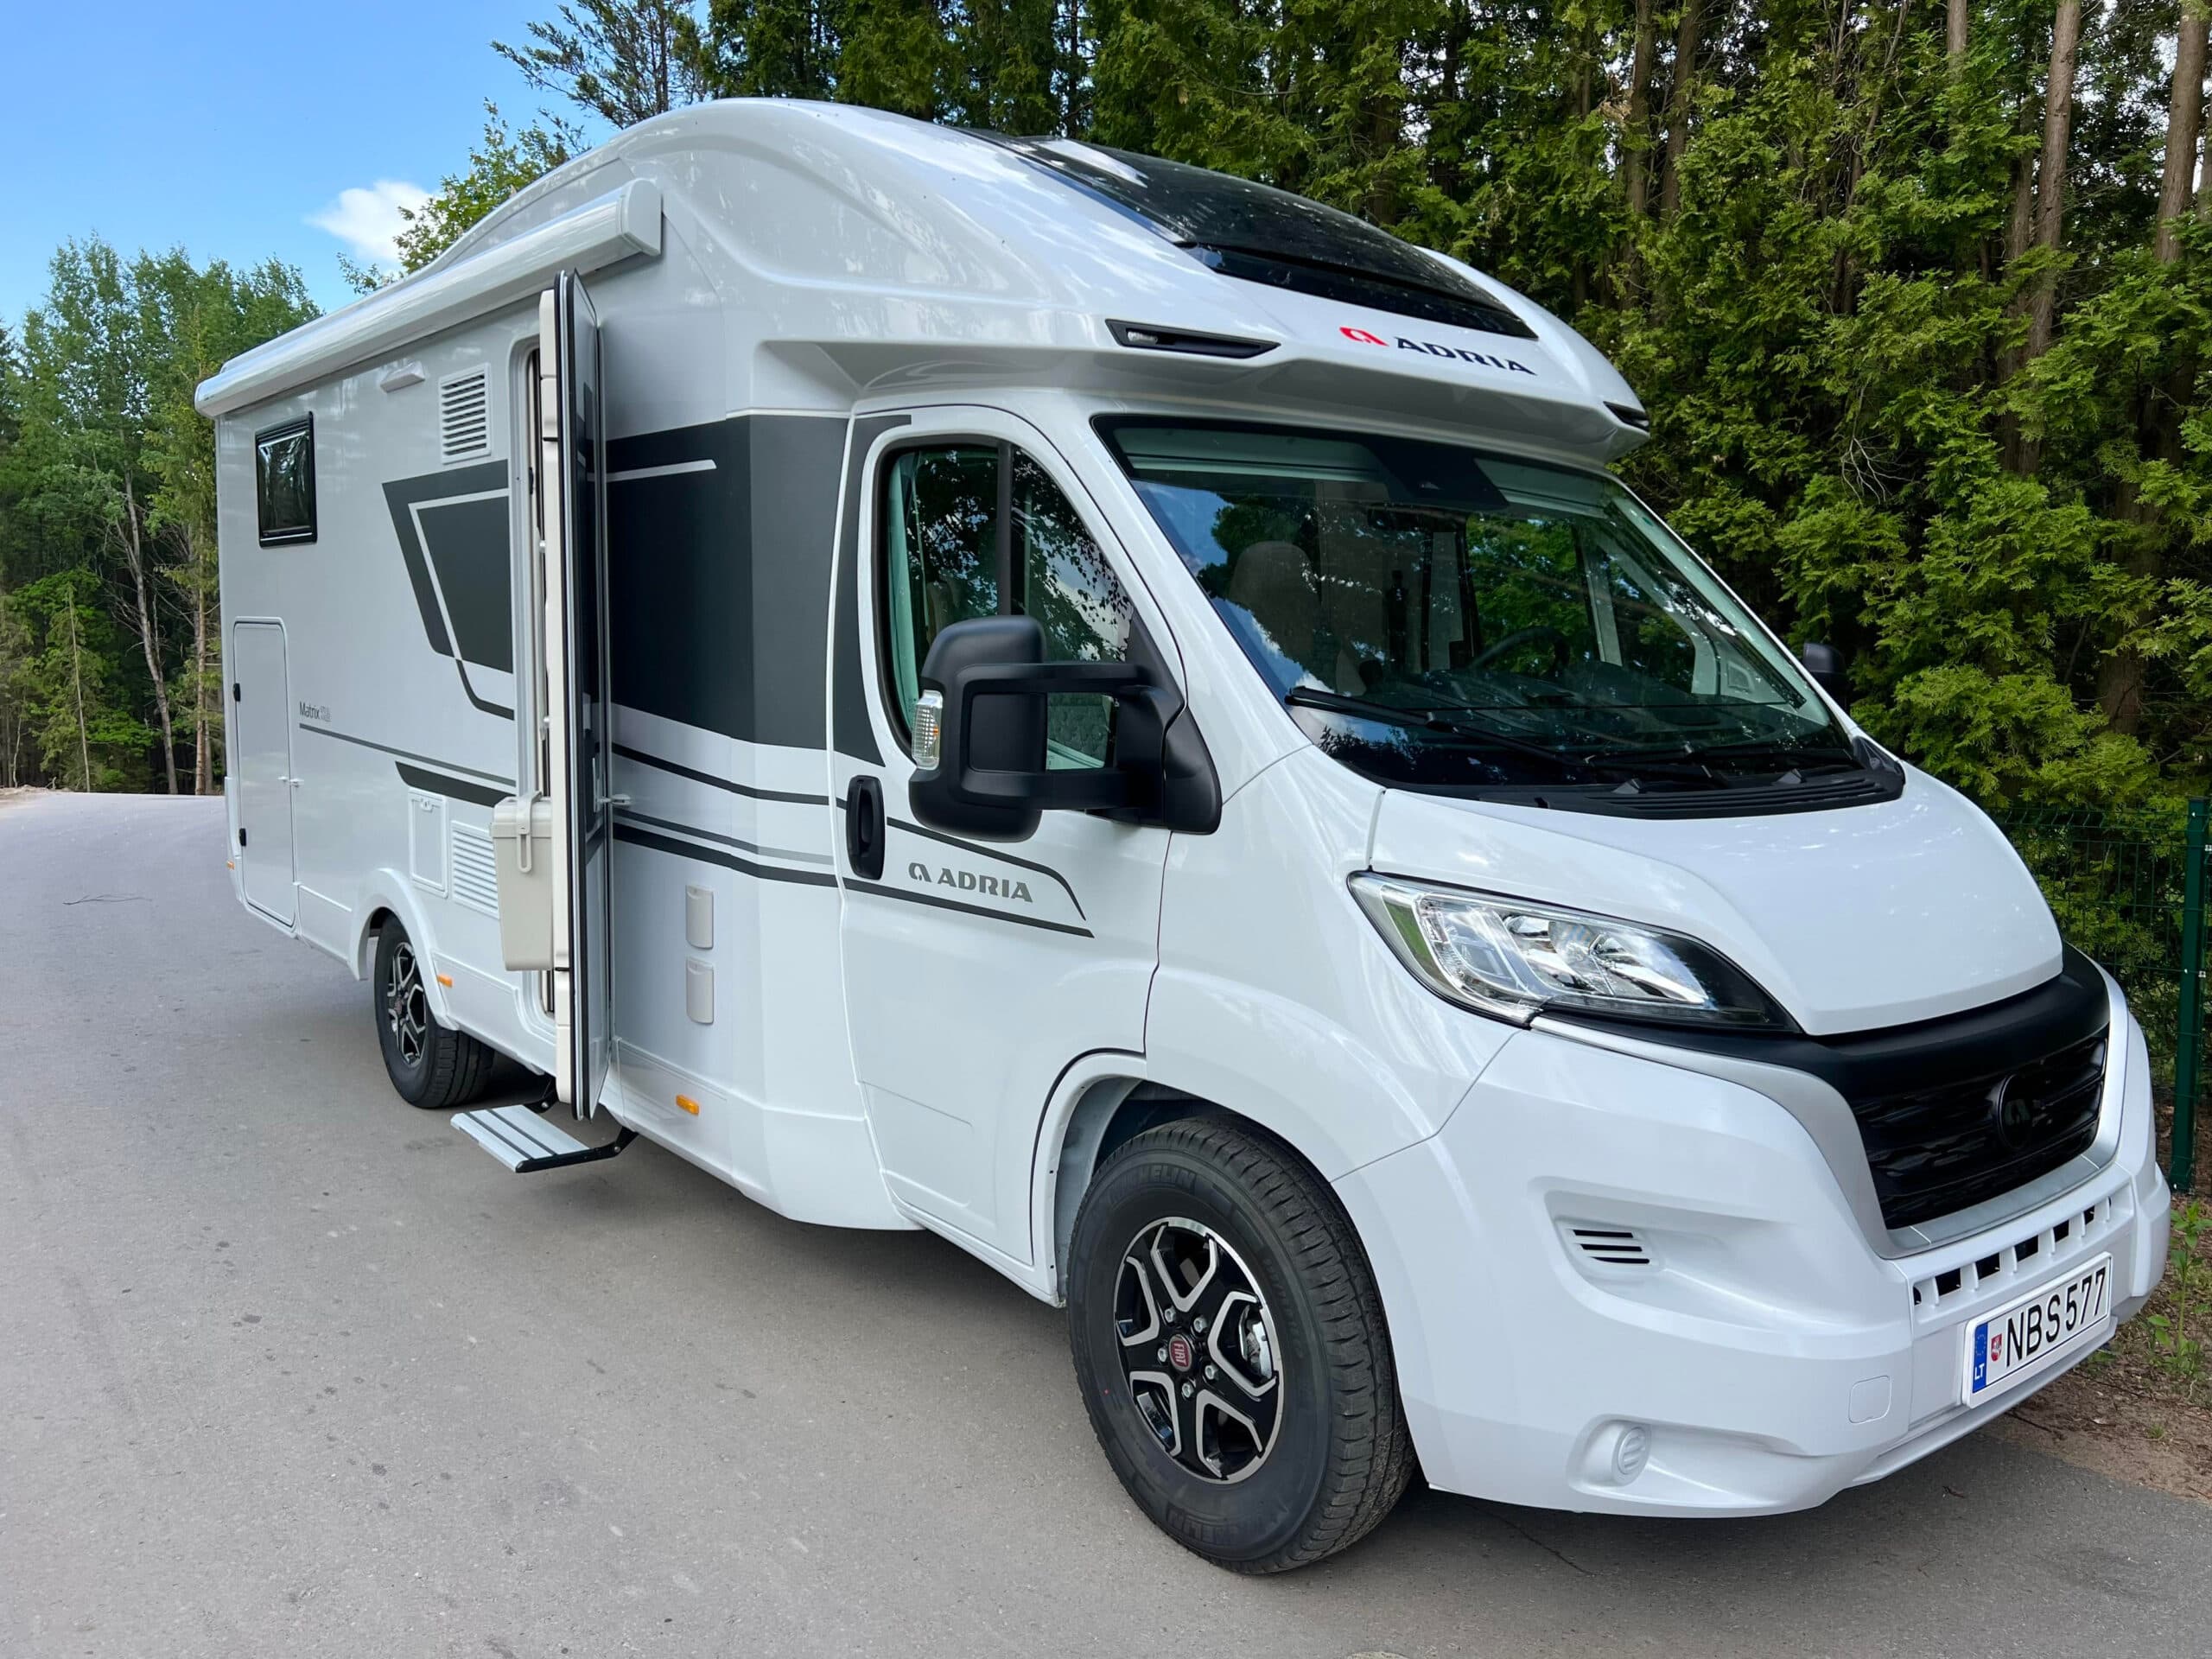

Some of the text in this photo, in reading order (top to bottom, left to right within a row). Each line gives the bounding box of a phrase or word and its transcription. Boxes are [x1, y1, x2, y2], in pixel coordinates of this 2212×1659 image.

[1394, 336, 1538, 376] ADRIA
[299, 701, 321, 720] Matrix
[937, 868, 1033, 903] ADRIA
[1173, 1343, 1187, 1365] FIAT
[1974, 1363, 1985, 1380] LT
